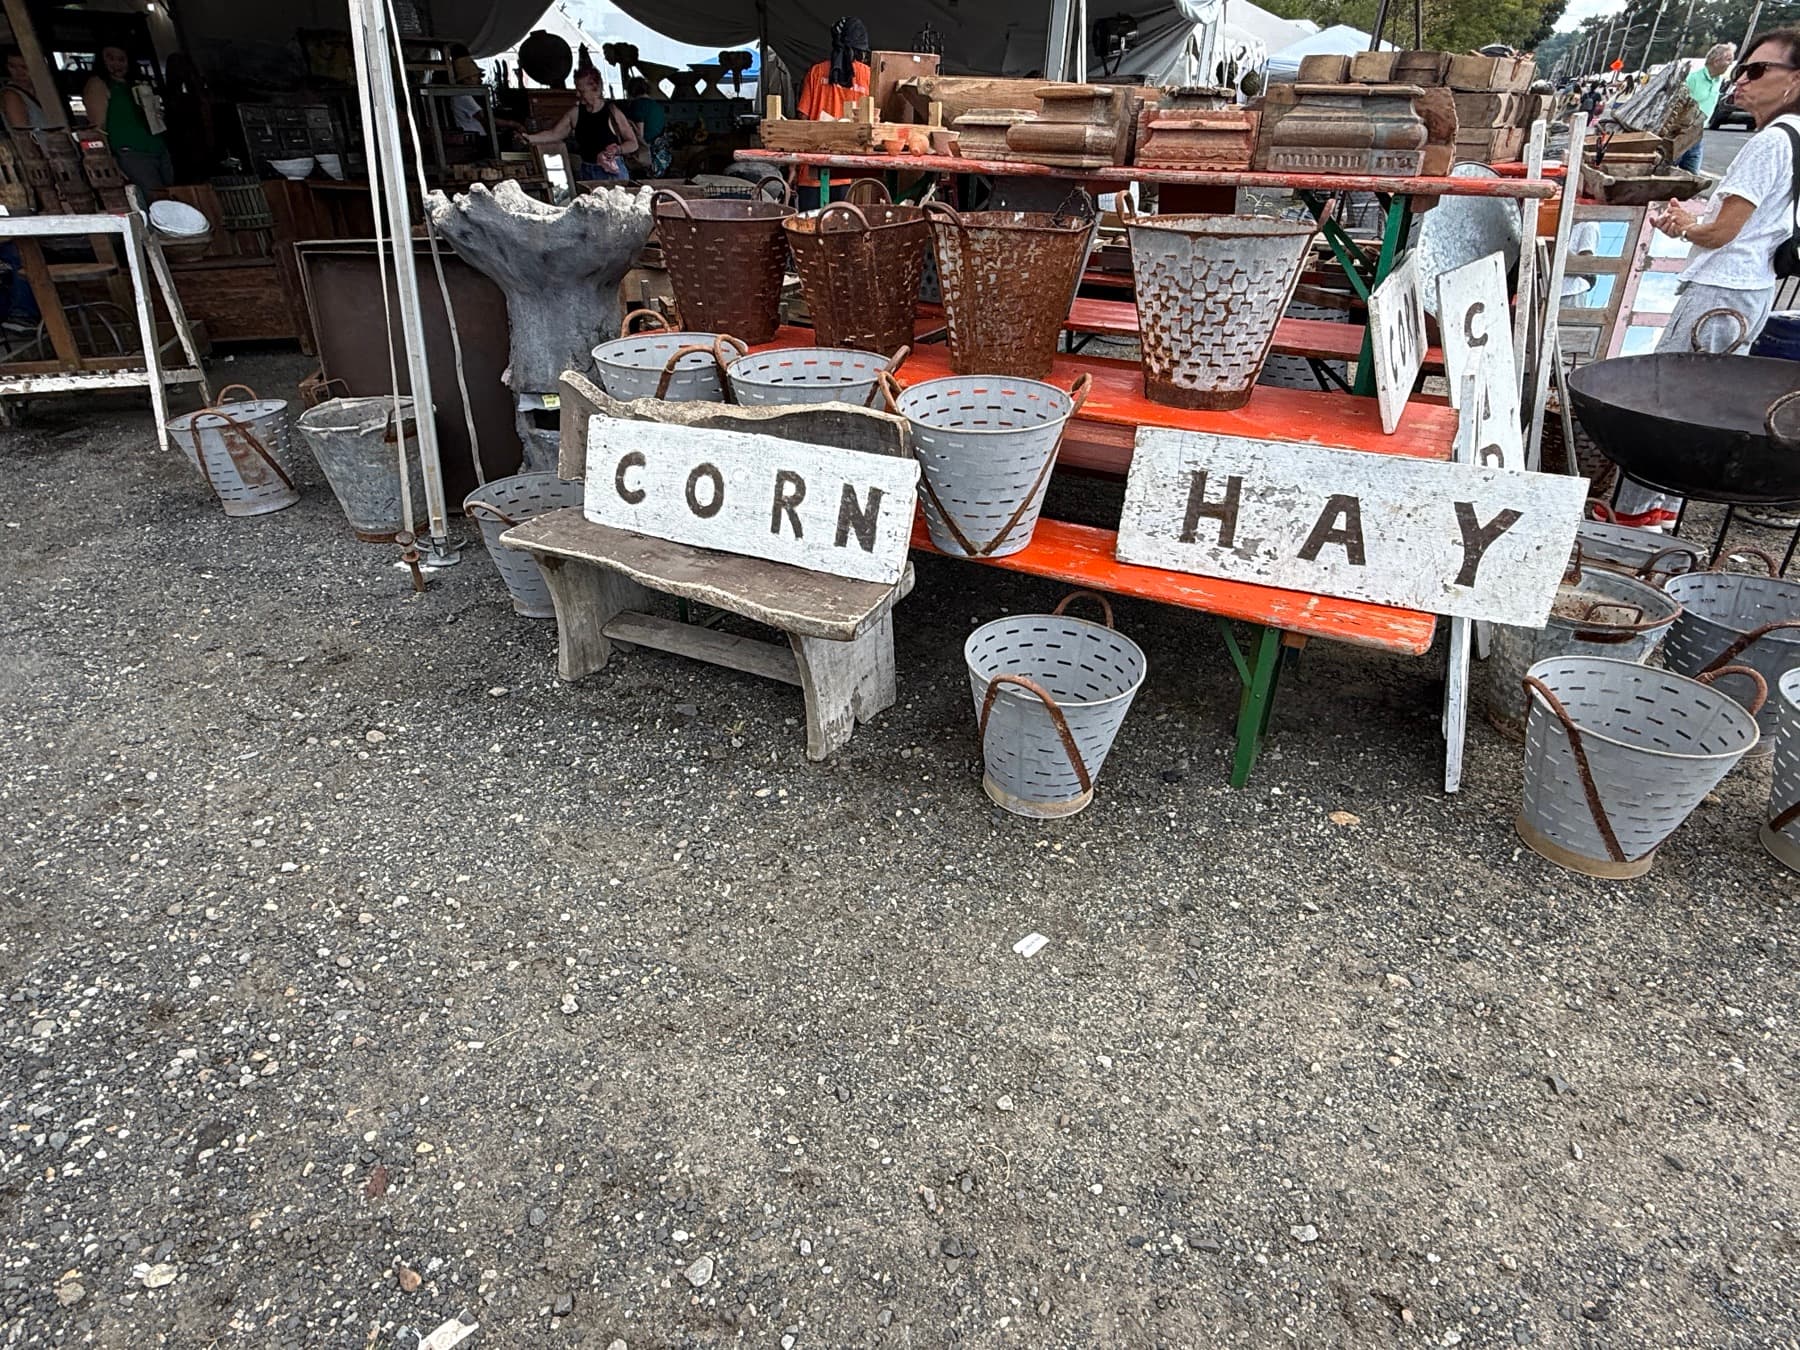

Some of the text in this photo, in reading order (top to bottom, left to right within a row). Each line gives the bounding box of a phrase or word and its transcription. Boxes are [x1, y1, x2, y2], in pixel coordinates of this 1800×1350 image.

[1390, 283, 1419, 383] CORN
[614, 450, 887, 554] CORN
[1179, 470, 1523, 588] HAY
